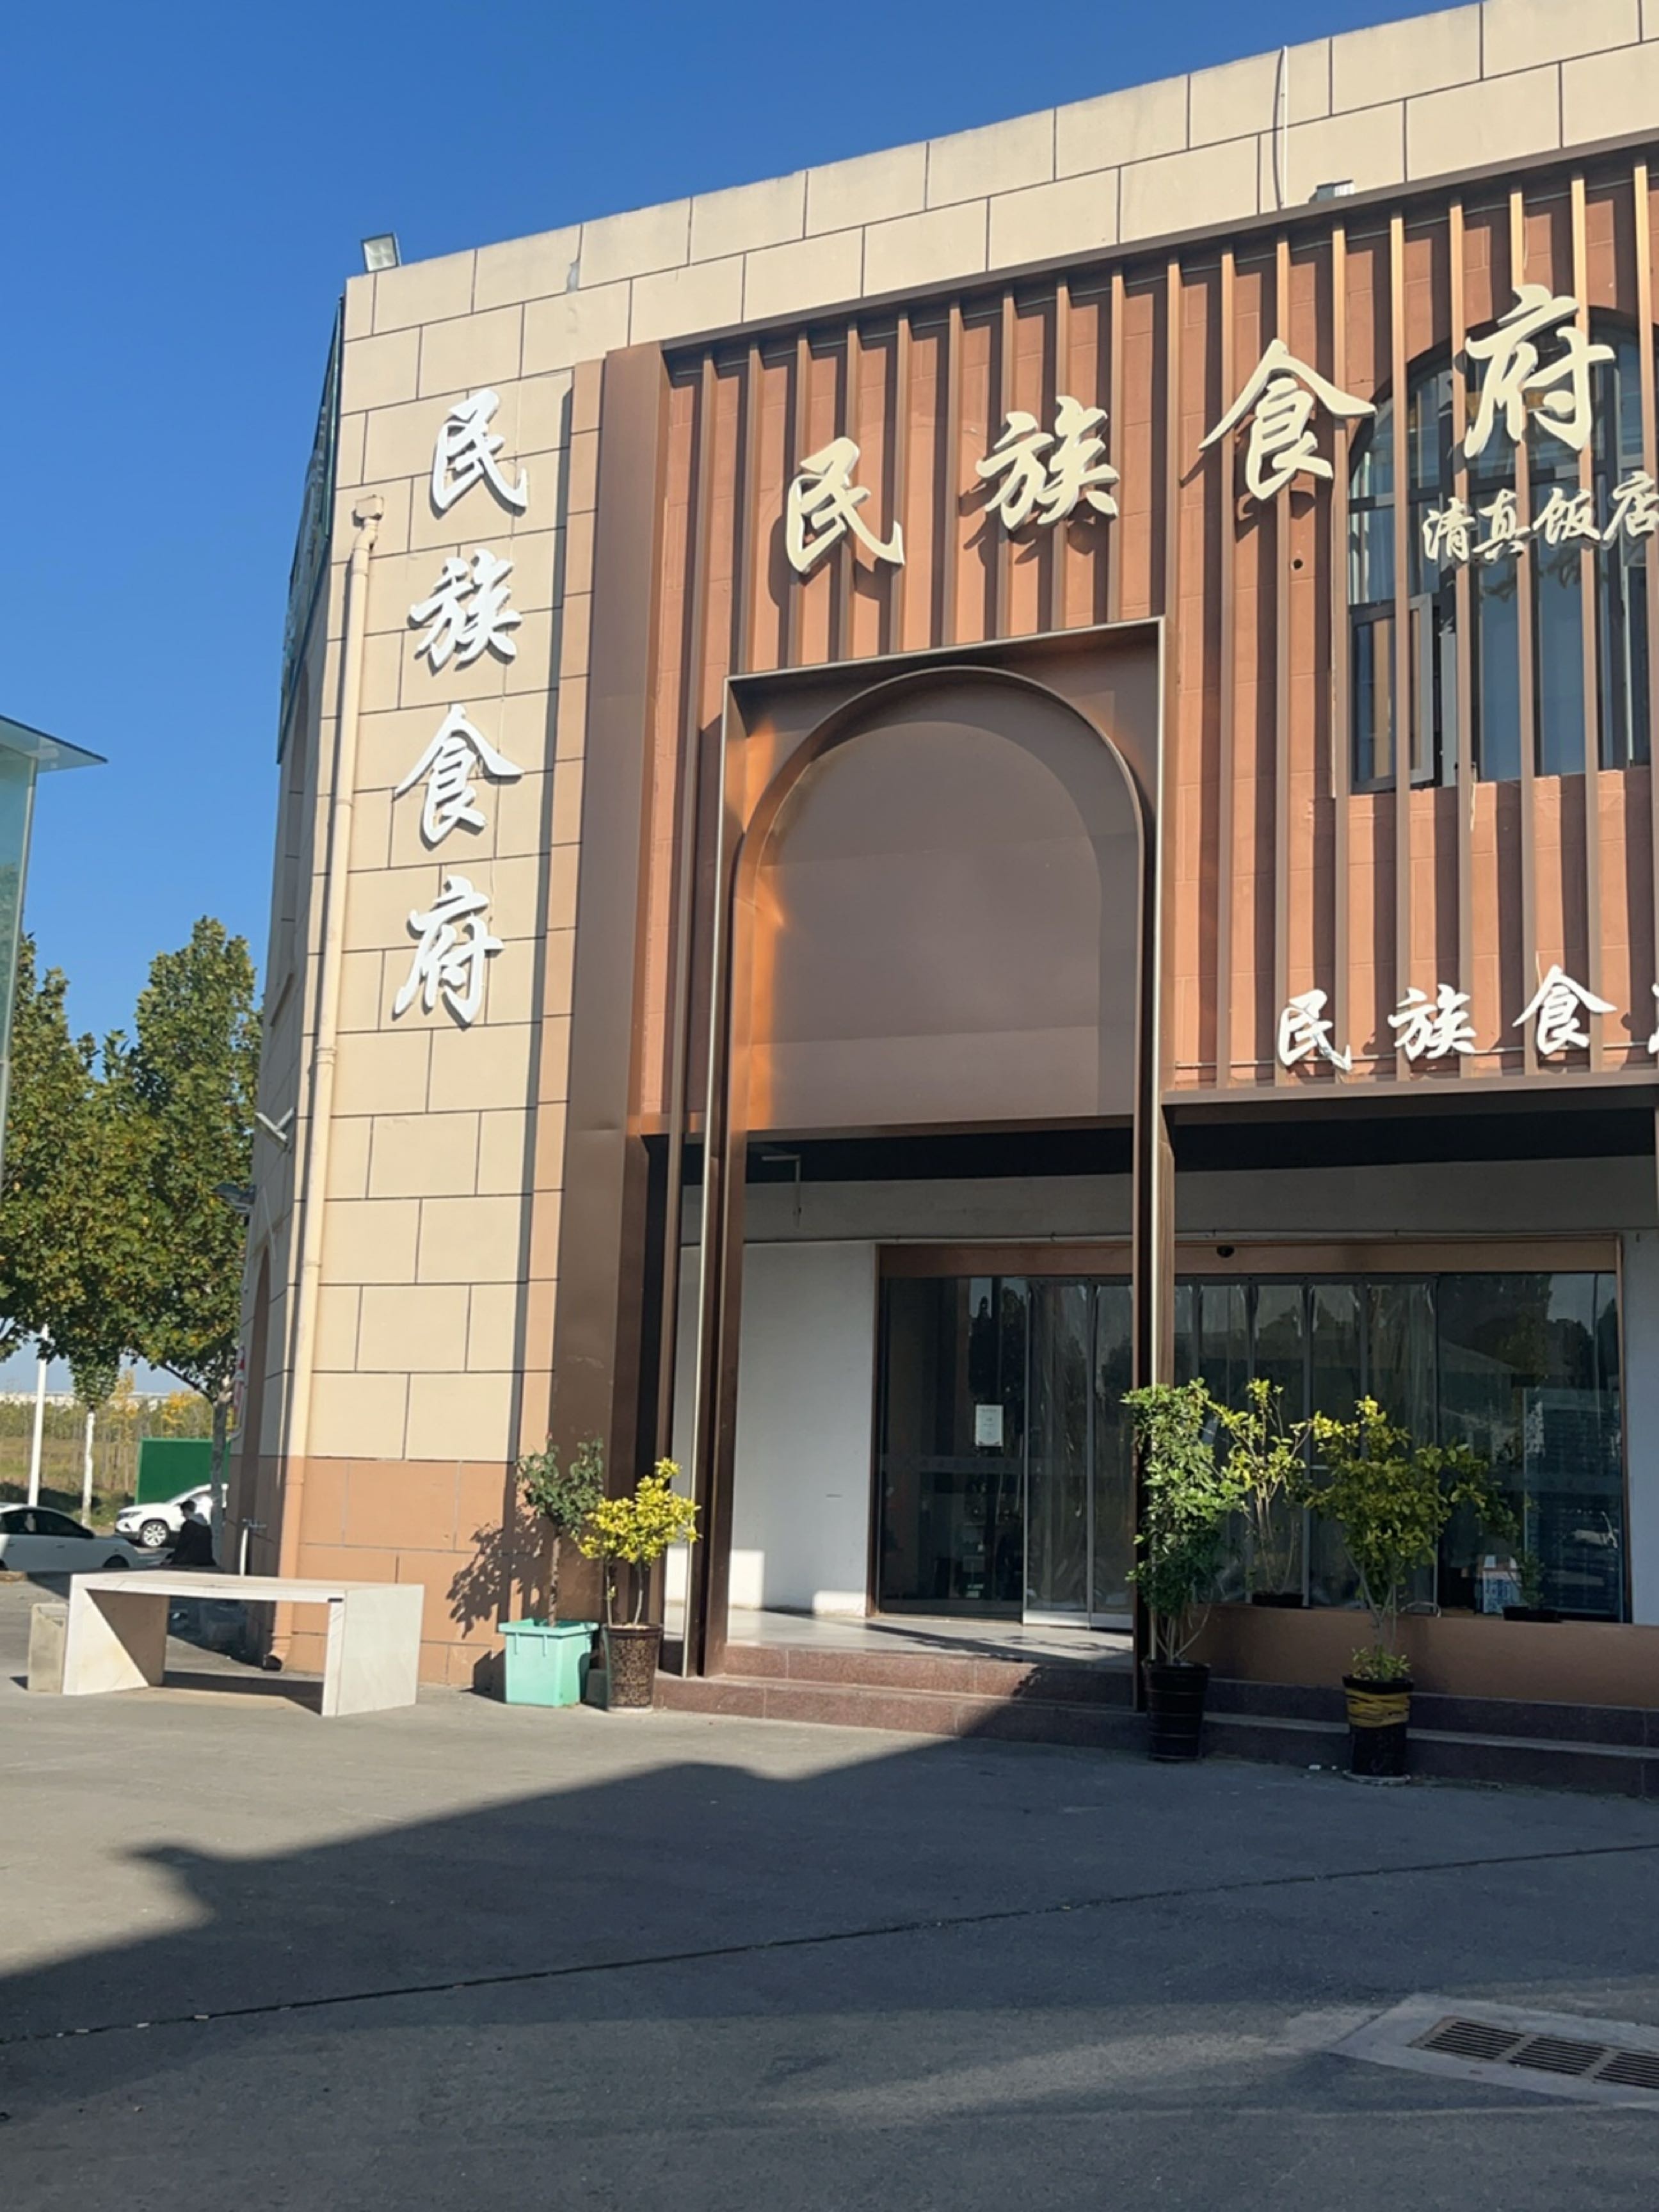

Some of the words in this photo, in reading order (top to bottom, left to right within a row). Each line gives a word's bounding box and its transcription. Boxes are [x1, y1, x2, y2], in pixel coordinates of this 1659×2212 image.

[785, 284, 1615, 572] 民族食府
[1422, 470, 1659, 561] 清真饭店
[394, 388, 530, 1025] 民族食府
[1279, 965, 1659, 1073] 民族食
